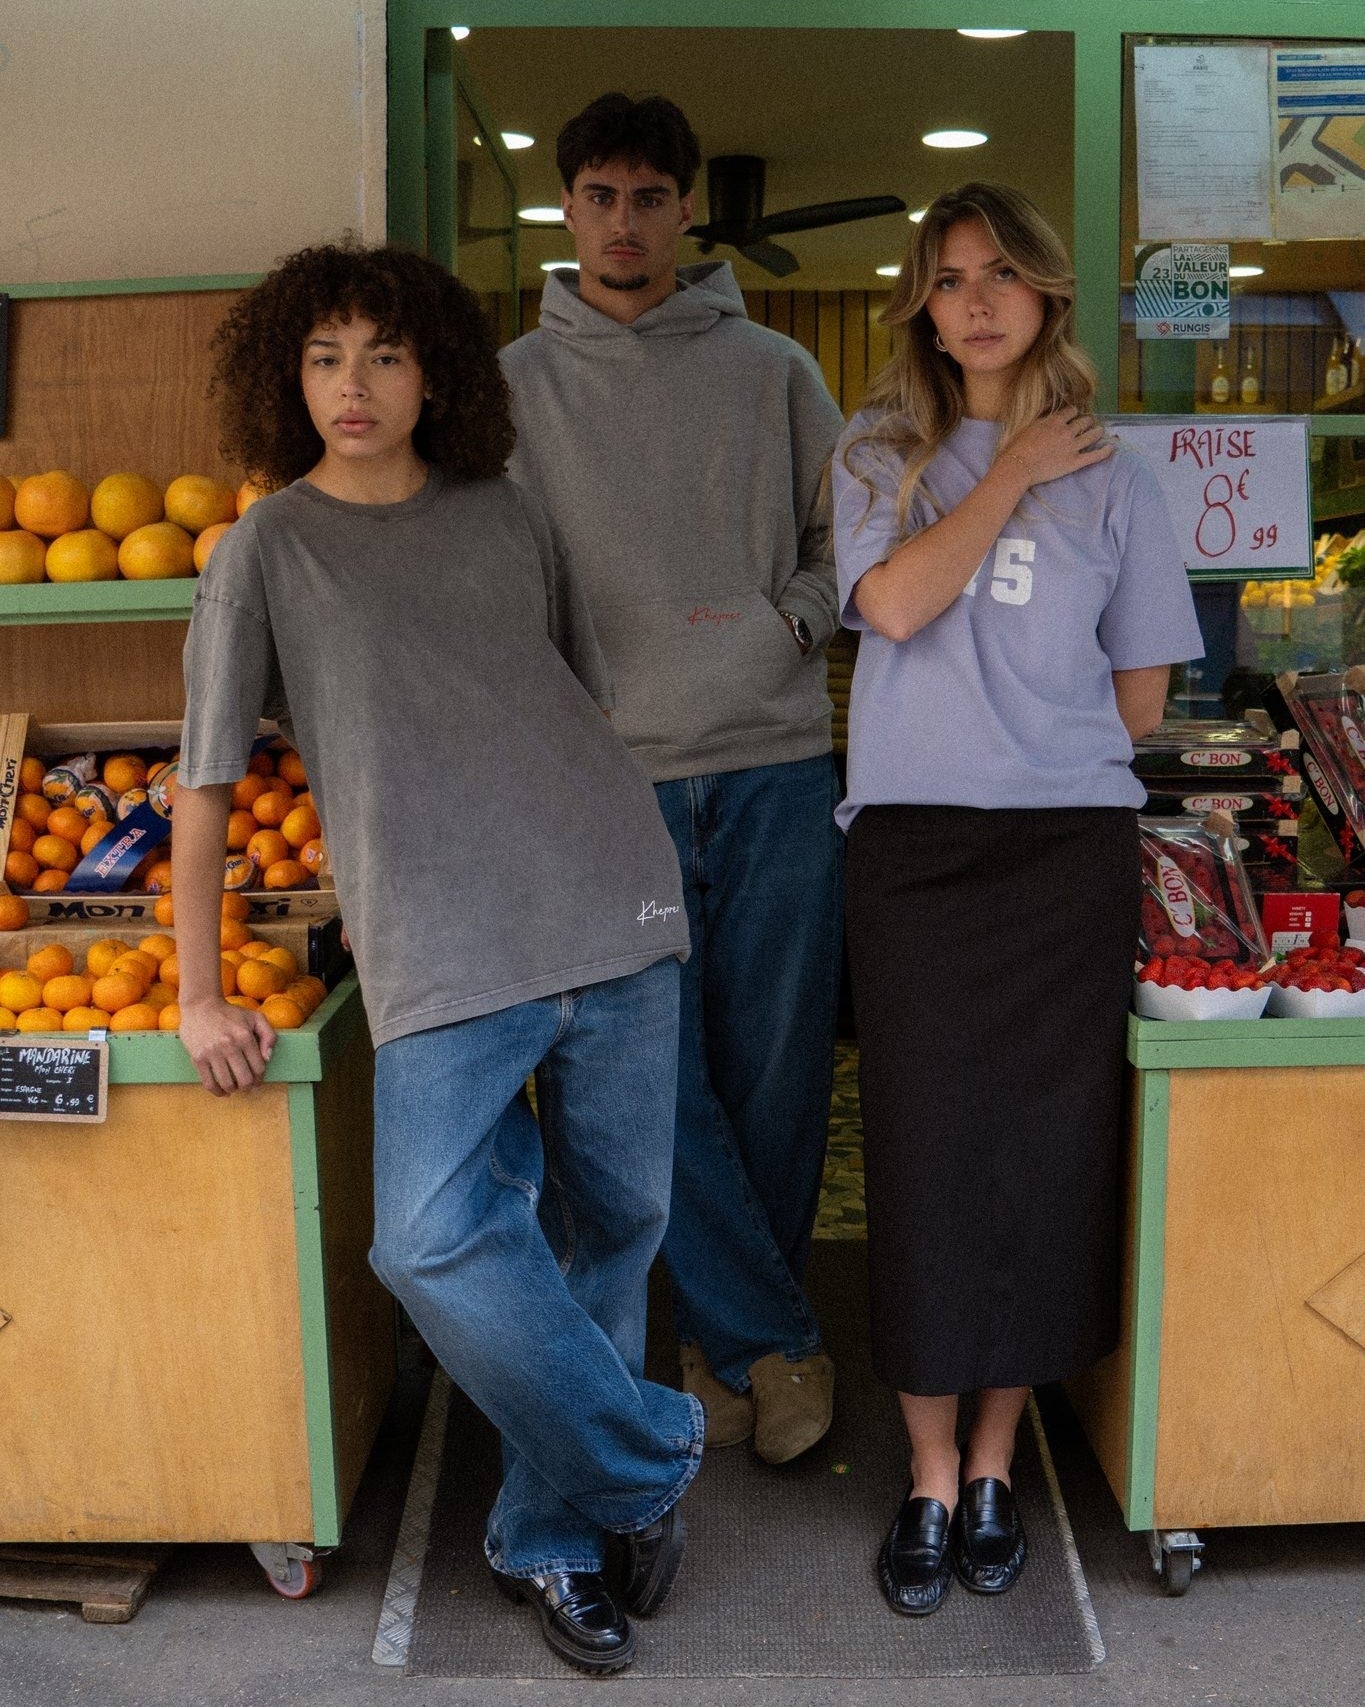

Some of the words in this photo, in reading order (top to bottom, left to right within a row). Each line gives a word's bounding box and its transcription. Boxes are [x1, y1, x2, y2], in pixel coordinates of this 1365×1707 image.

[1153, 267, 1170, 279] 23
[1173, 261, 1228, 273] VALEUR
[1173, 280, 1228, 300] BON
[1173, 323, 1210, 333] RUNGIS
[1169, 428, 1257, 469] FRAISE
[1209, 753, 1242, 765] BON
[1314, 778, 1335, 806] BON
[1211, 798, 1244, 810] BON
[94, 828, 147, 878] EXTRA
[1161, 865, 1189, 903] BON
[47, 901, 146, 919] Mon
